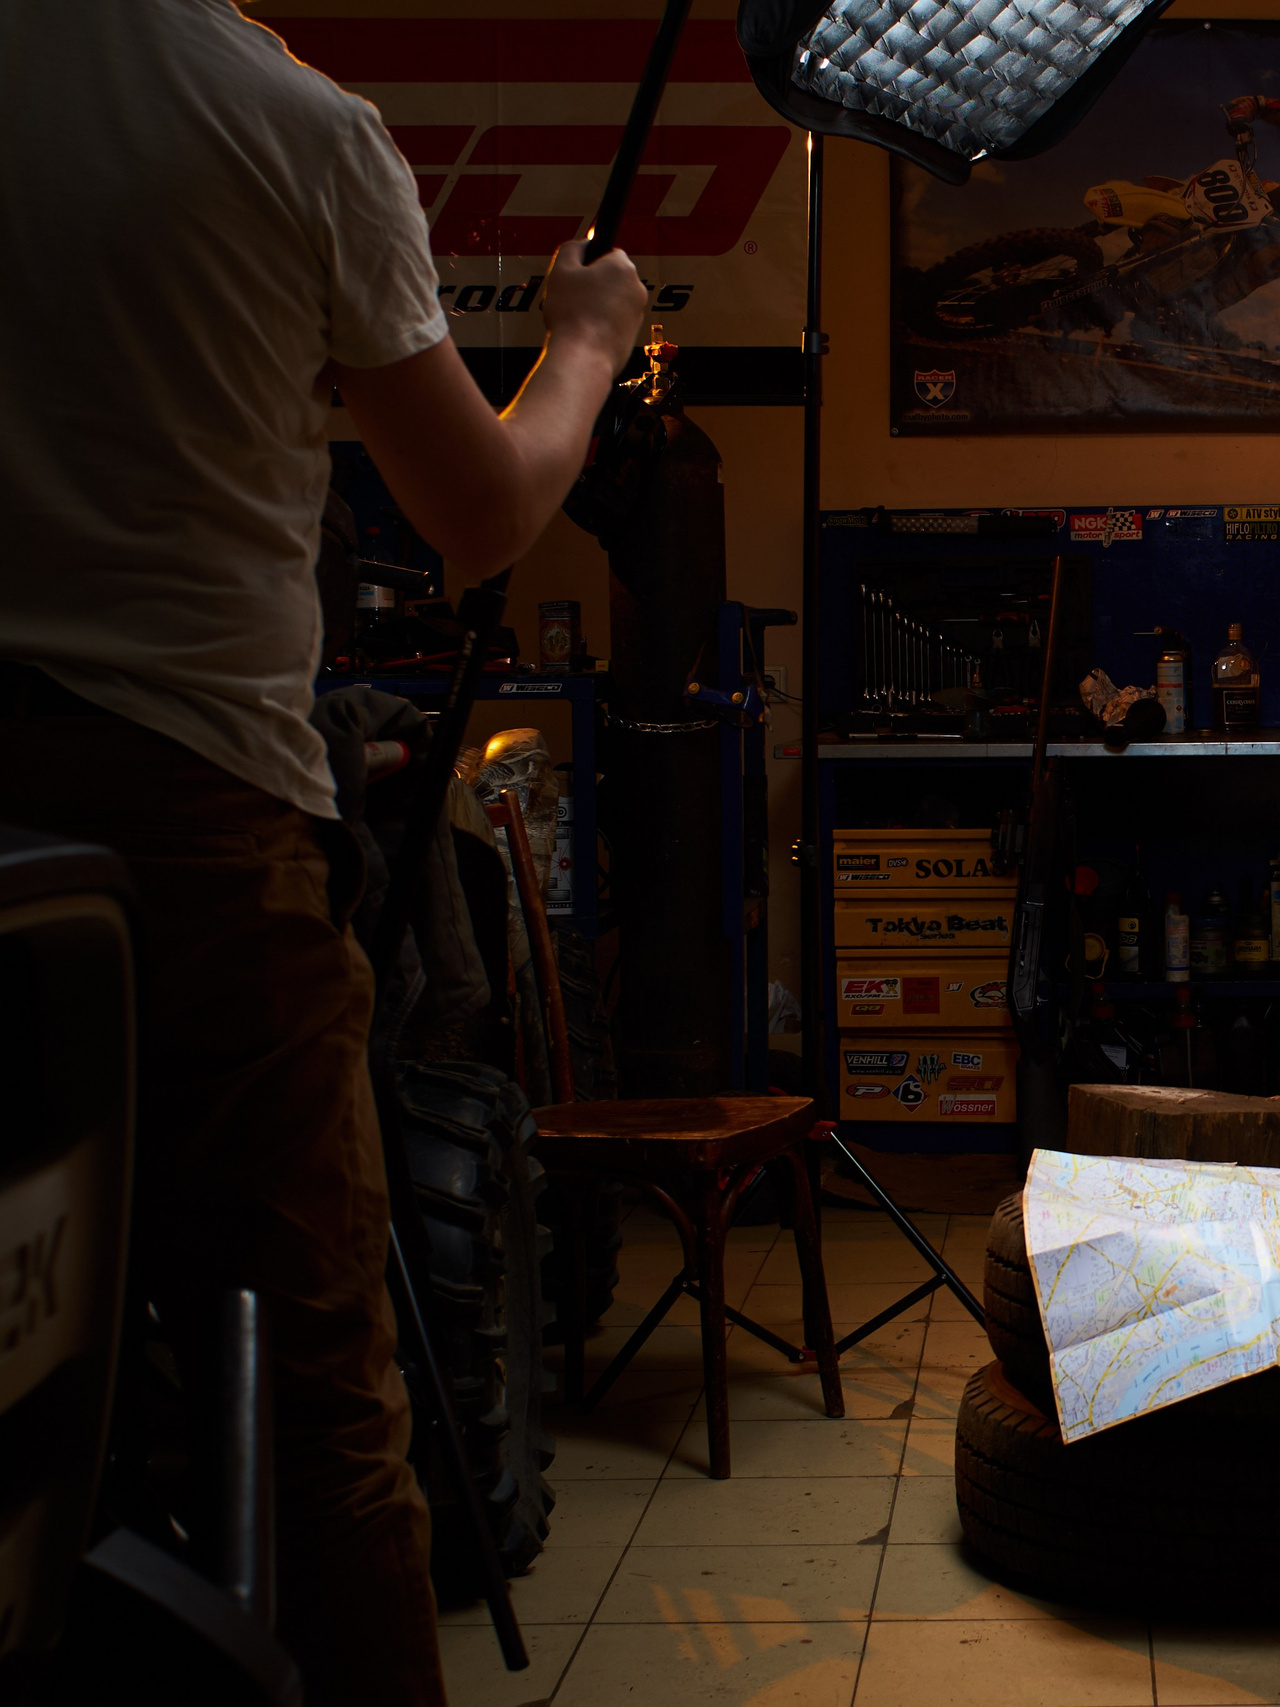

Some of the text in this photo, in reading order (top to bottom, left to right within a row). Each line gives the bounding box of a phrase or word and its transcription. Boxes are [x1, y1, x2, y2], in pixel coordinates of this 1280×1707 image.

[925, 382, 945, 400] X
[1245, 508, 1262, 519] ATV
[1074, 517, 1107, 529] NGK
[1074, 530, 1140, 541] motor sport
[839, 856, 877, 865] maier
[866, 915, 1008, 936] Tokyo Beat
[844, 980, 886, 993] EK
[846, 1055, 888, 1065] VENHILL
[953, 1053, 981, 1066] EBC
[941, 1095, 994, 1114] Wössner
